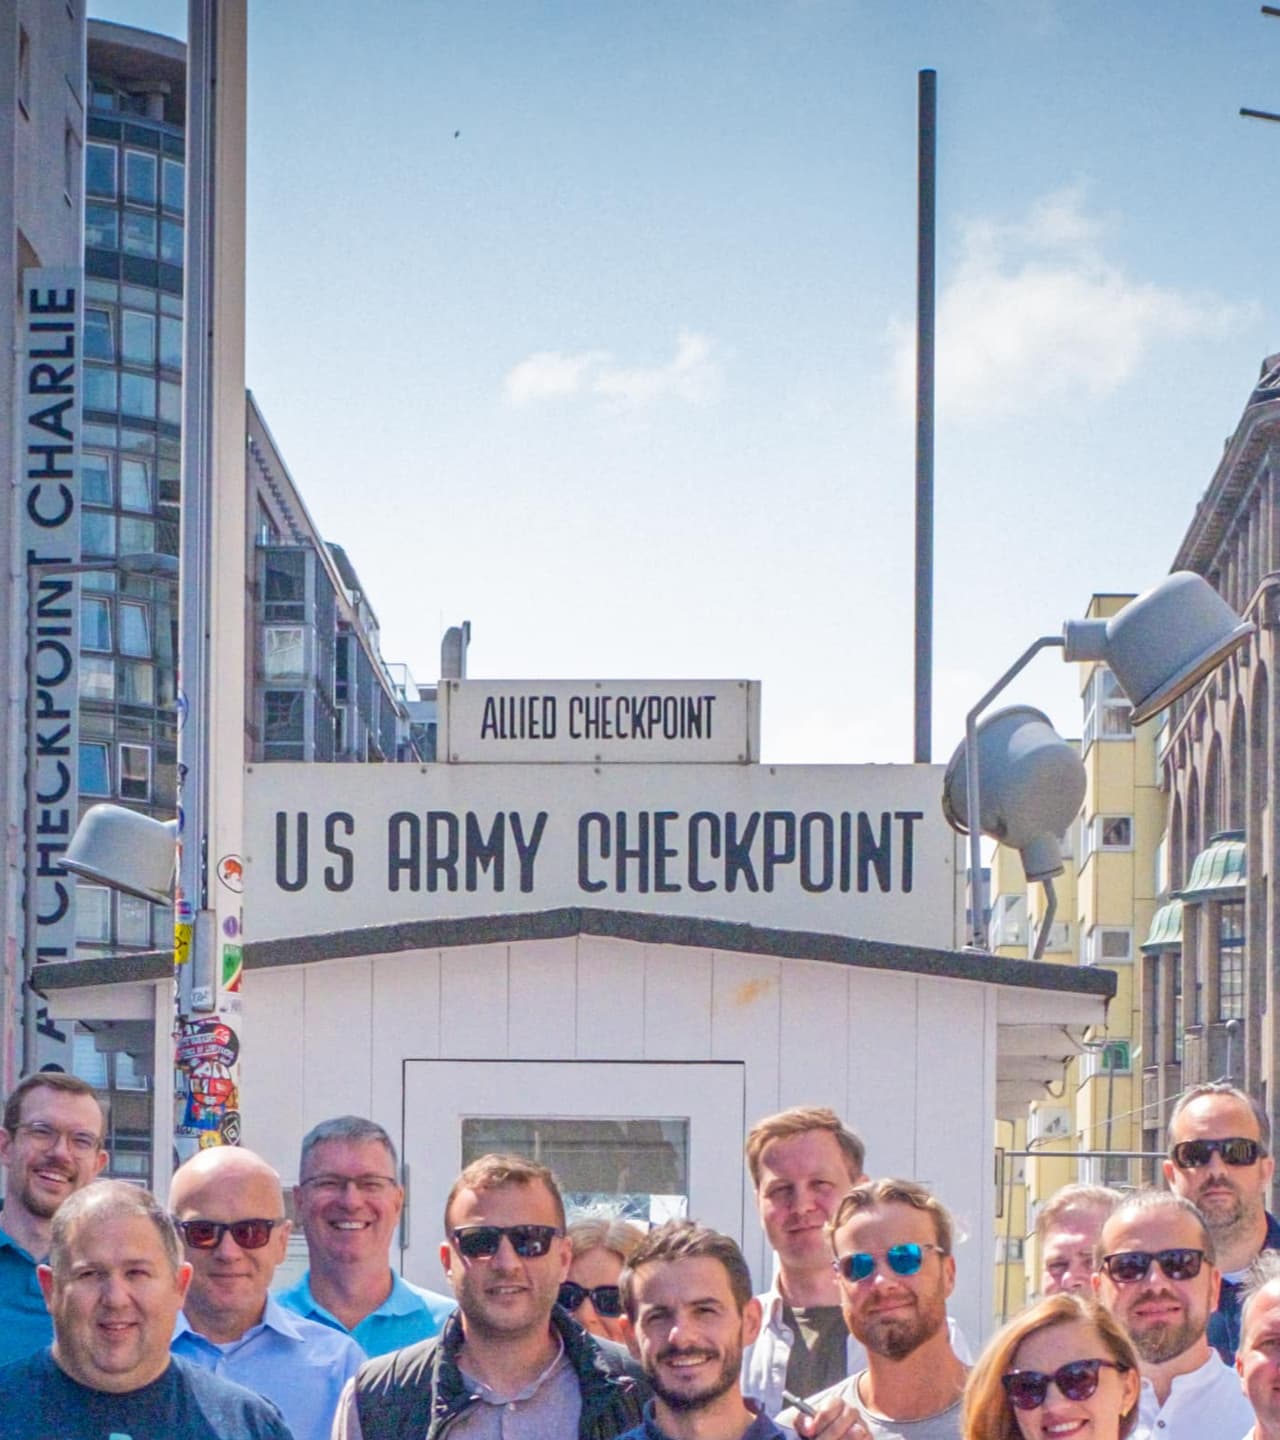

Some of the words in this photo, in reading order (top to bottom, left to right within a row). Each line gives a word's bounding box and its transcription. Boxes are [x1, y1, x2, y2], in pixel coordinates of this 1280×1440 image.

[27, 289, 75, 528] CHARLIE
[25, 549, 73, 926] CHECKPOINT
[481, 696, 556, 739] ALLIED
[569, 696, 716, 739] CHECKPOINT
[275, 811, 354, 893] US
[388, 811, 549, 893] ARMY
[578, 811, 923, 893] CHECKPOINT
